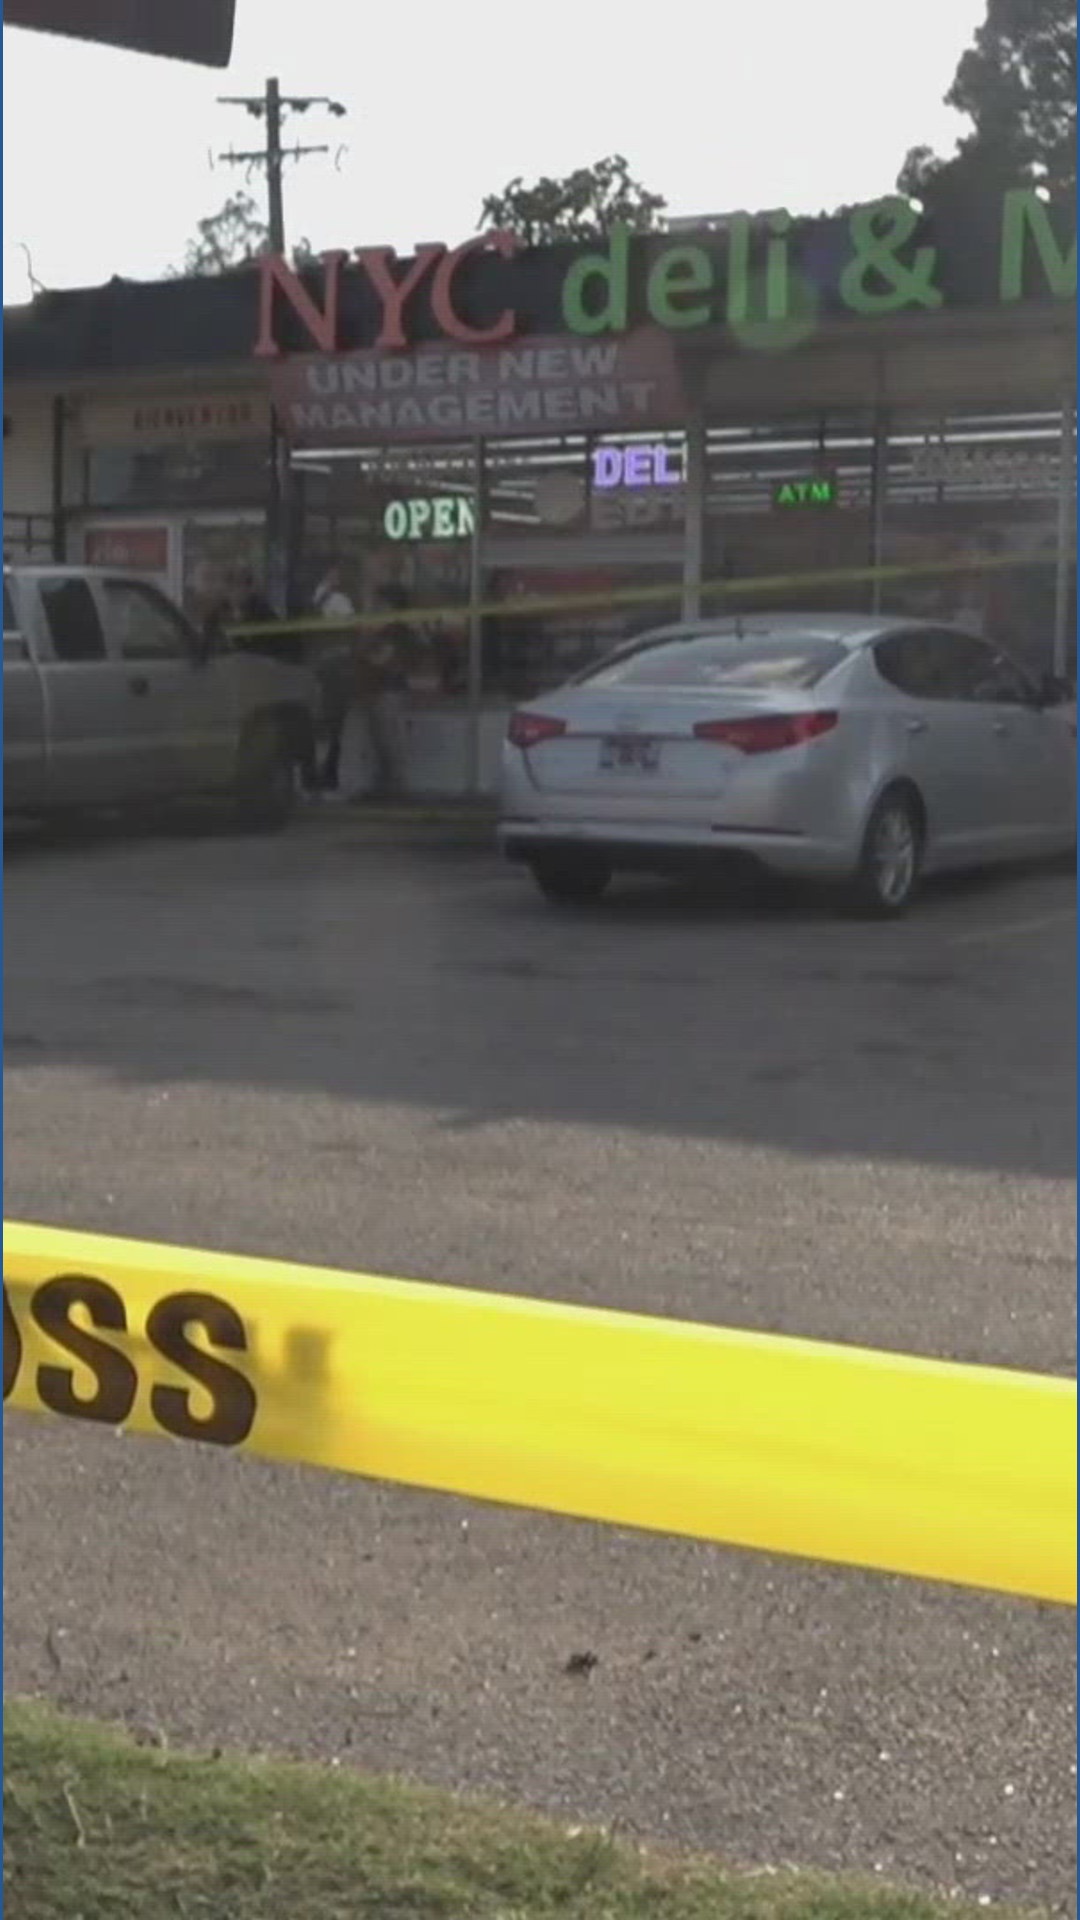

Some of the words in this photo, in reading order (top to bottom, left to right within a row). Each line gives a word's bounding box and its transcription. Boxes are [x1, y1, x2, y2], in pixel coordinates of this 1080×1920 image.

[254, 228, 527, 356] NYC
[561, 209, 790, 336] deli
[839, 193, 944, 313] &
[306, 353, 480, 394] UNDER
[498, 343, 618, 379] NEW
[291, 382, 656, 430] MANAGEMENT
[778, 482, 831, 504] ATM
[384, 497, 476, 540] OPEN
[3, 1273, 257, 1446] SS
